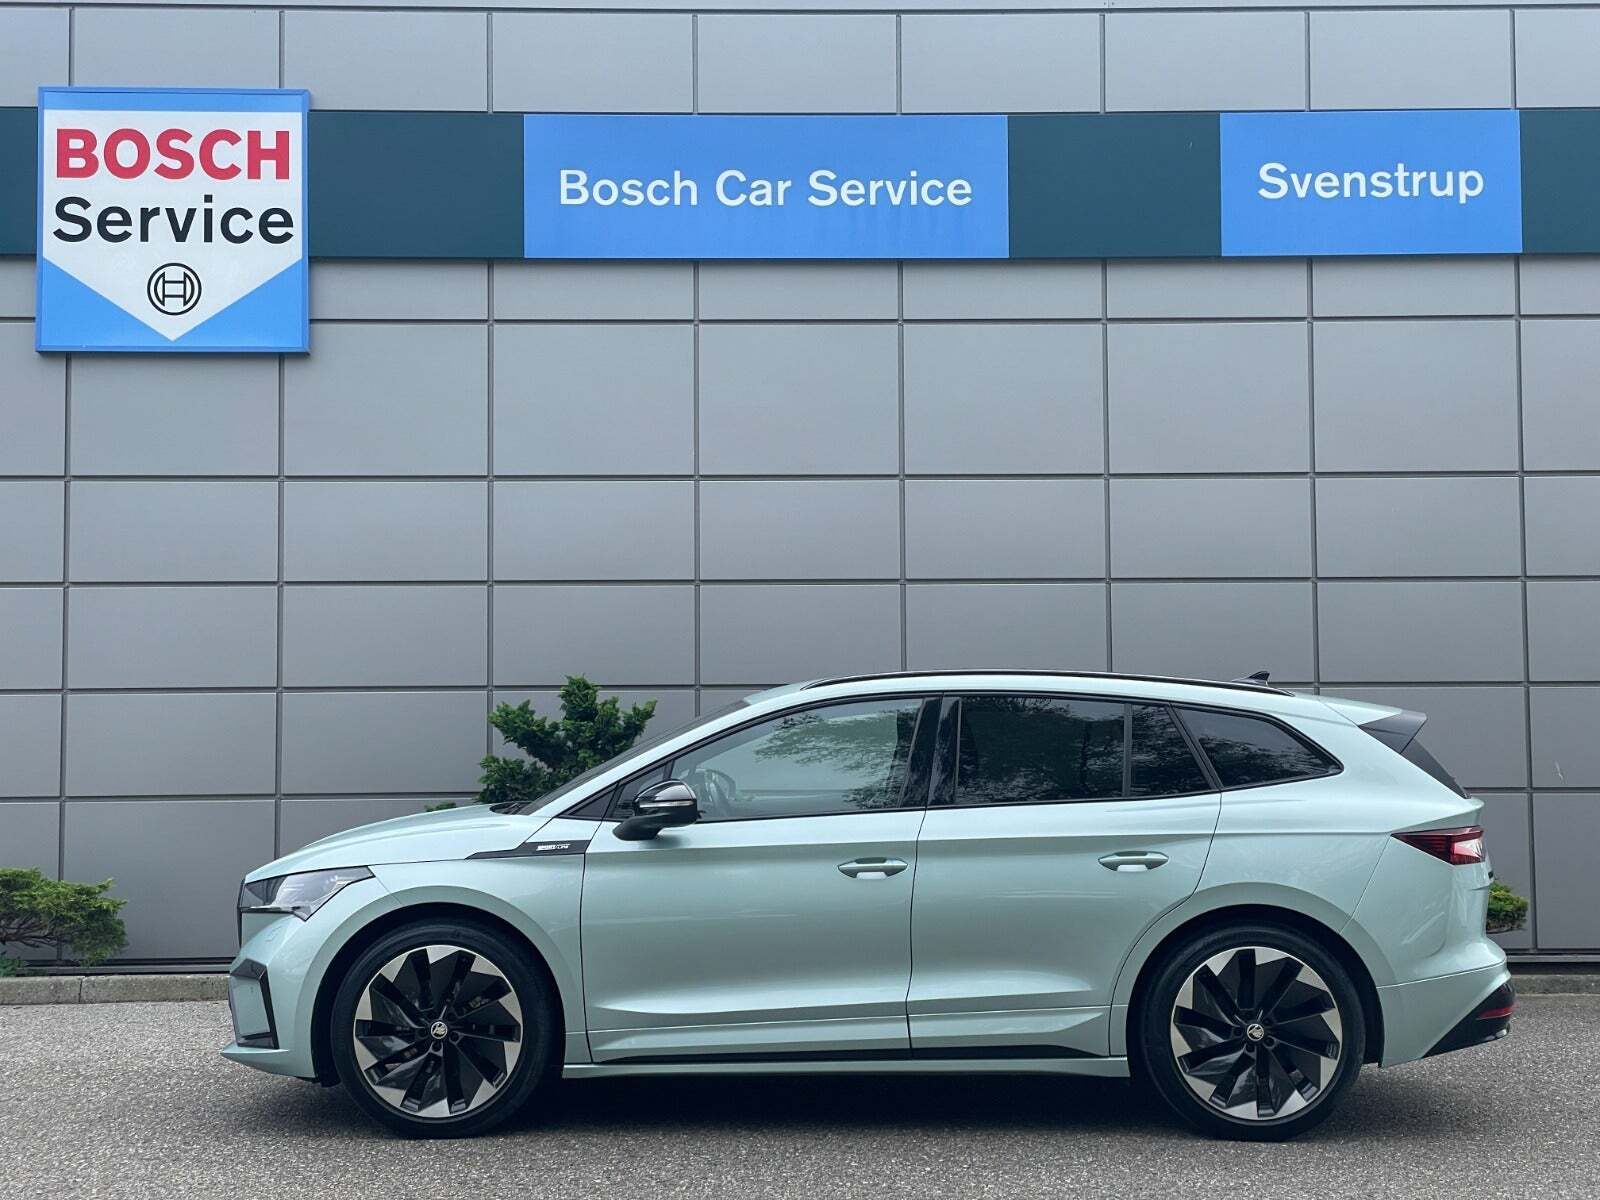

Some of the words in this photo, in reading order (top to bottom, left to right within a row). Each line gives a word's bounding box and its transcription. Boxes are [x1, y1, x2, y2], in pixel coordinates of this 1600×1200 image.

[56, 128, 290, 181] BOSCH
[559, 169, 698, 207] Bosch
[715, 169, 793, 207] Car
[807, 169, 973, 207] Service
[1257, 162, 1485, 204] Svenstrup
[52, 194, 294, 245] Service
